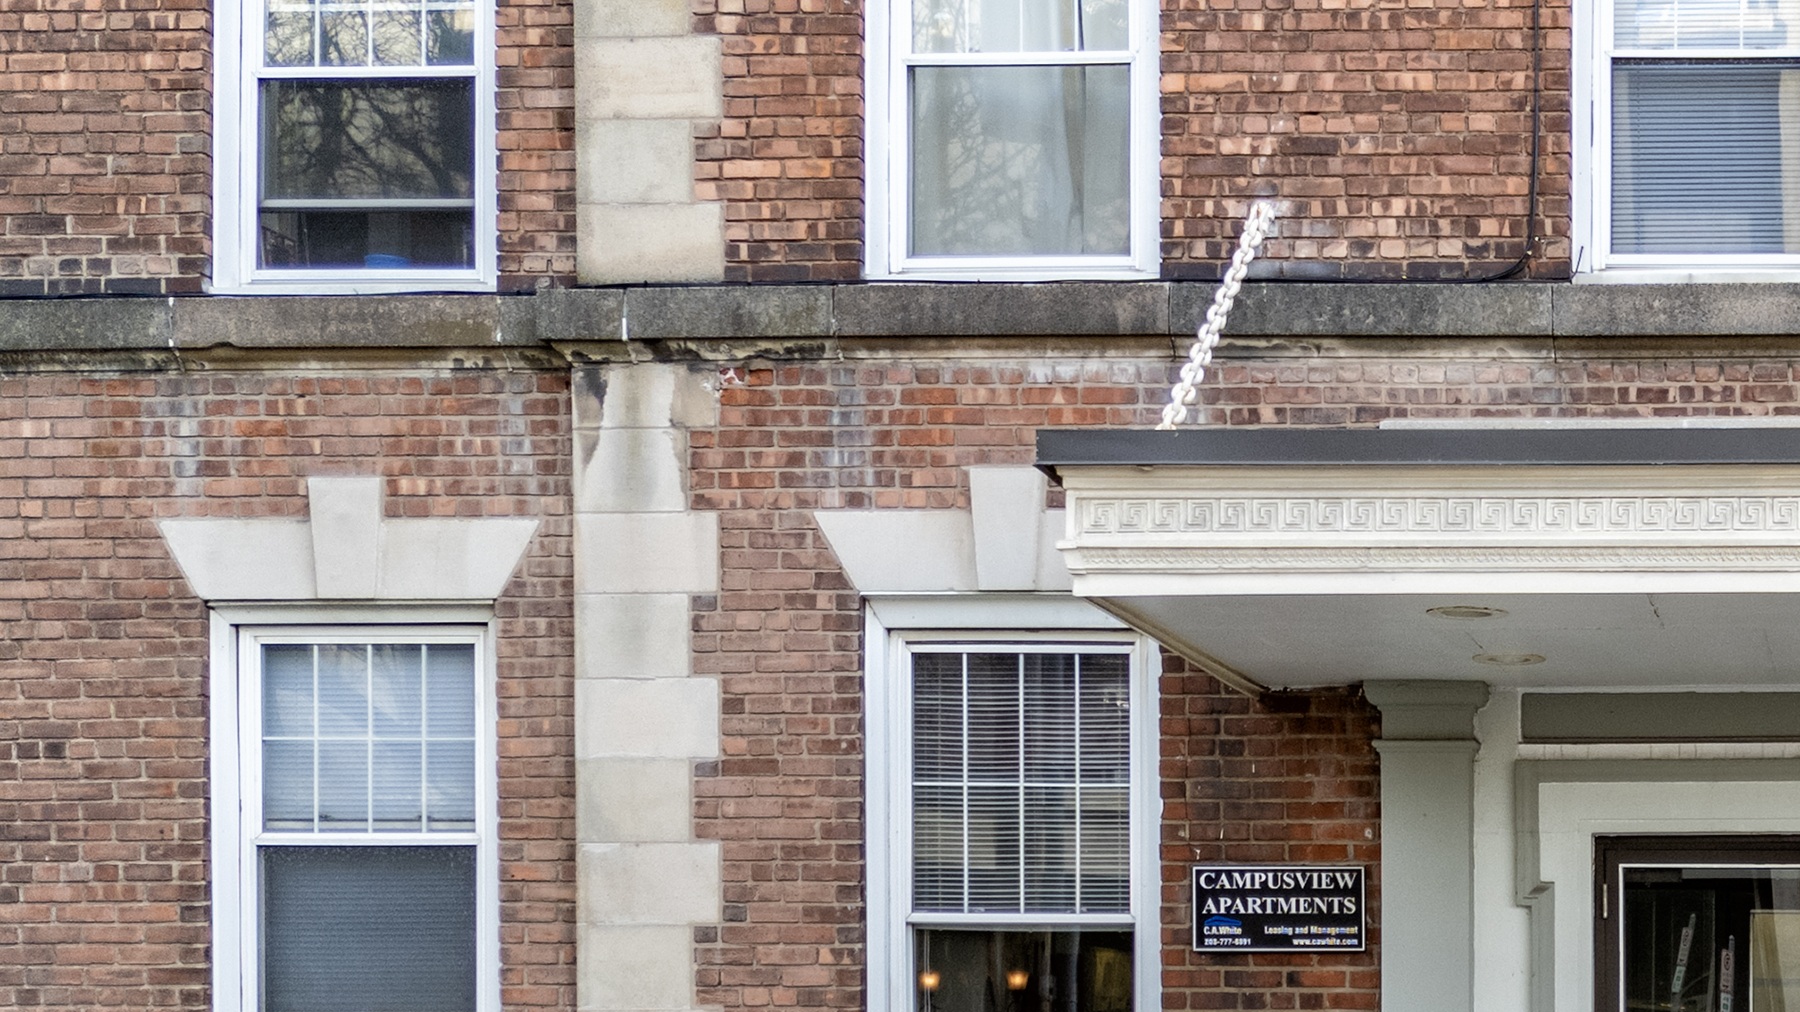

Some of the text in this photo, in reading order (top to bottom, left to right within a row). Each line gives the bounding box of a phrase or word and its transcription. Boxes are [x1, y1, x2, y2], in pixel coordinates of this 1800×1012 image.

[1199, 872, 1357, 889] CAMPUSVIEW
[1202, 897, 1357, 914] APARTMENTS
[1264, 925, 1358, 936] Leasing and Management
